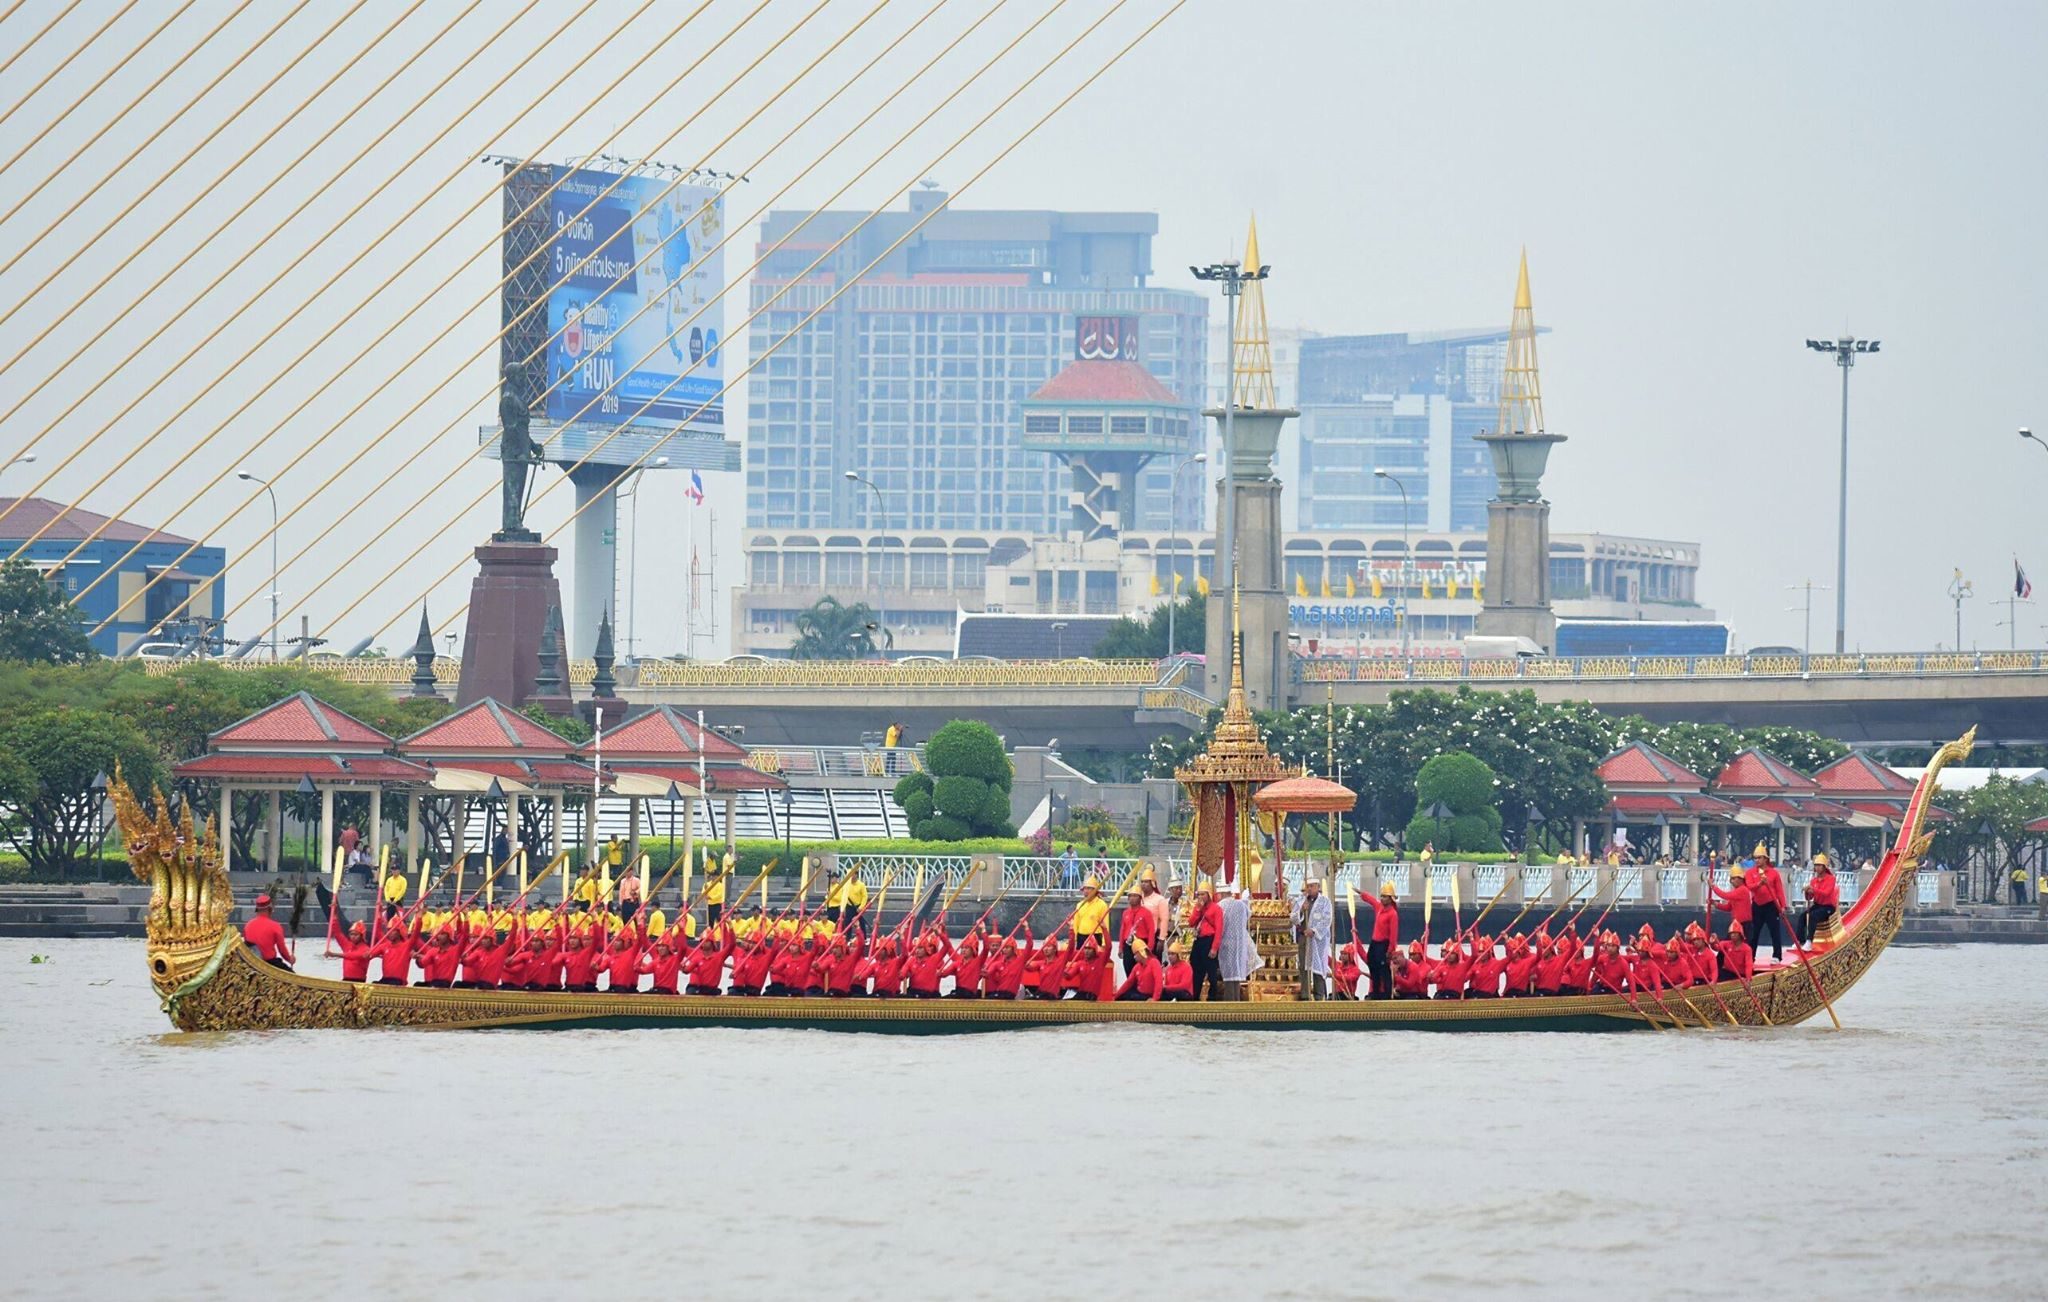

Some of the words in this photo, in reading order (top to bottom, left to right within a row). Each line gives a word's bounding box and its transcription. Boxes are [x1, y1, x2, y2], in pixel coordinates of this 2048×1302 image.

[556, 246, 564, 273] 5
[584, 357, 614, 392] RUN
[601, 394, 619, 414] 2019
